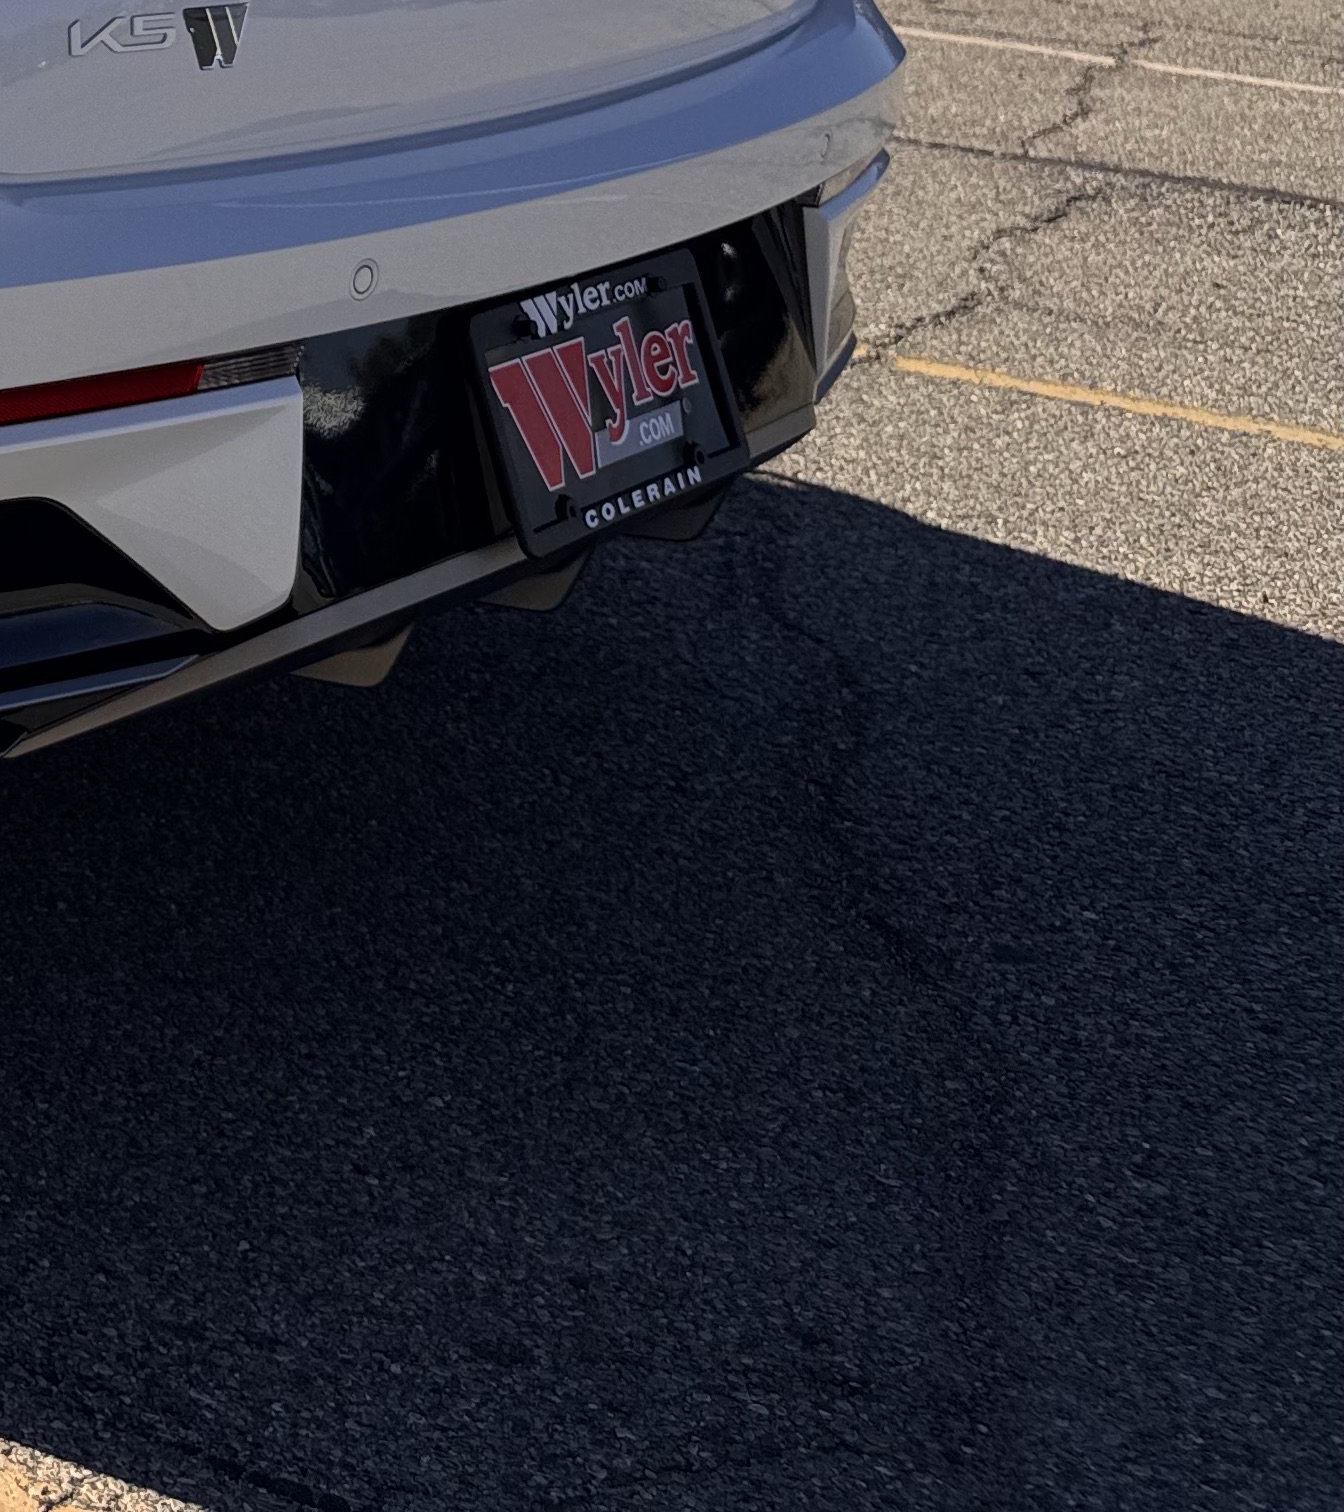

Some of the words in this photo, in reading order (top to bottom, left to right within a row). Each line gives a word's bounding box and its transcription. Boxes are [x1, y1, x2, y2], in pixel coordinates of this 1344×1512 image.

[68, 11, 176, 56] K5
[488, 315, 699, 492] Wyler
[585, 465, 702, 529] COLERAIN
